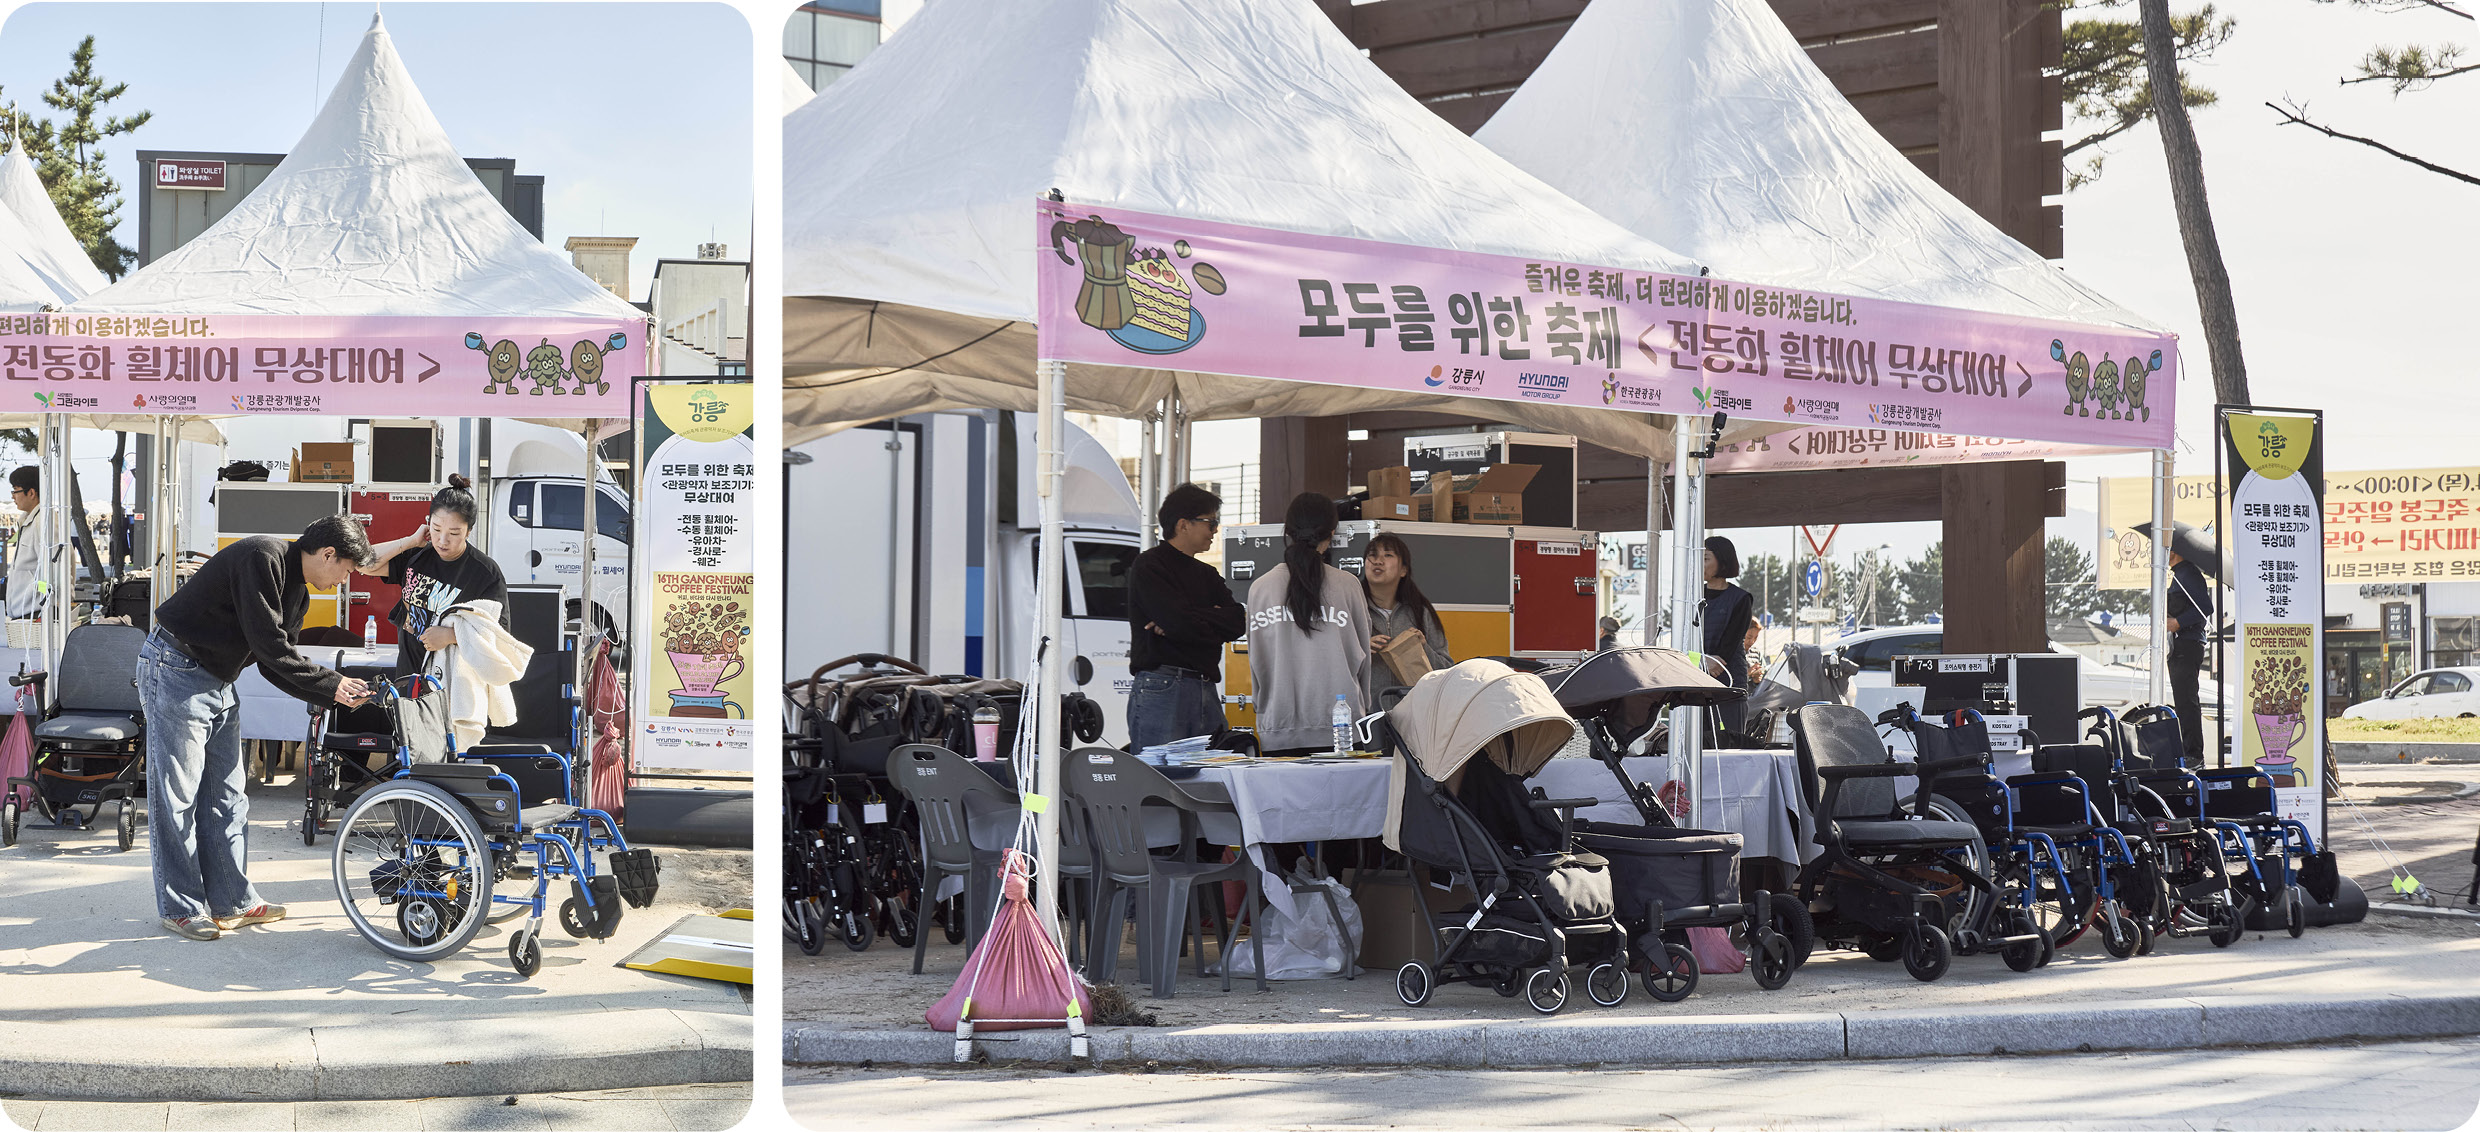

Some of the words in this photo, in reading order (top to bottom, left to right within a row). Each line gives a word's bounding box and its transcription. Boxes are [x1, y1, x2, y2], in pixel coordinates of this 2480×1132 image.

[1525, 264, 1581, 296] 즐거운
[1588, 270, 1630, 304] 축제,
[1636, 276, 1652, 304] 더
[1658, 278, 1728, 312] 편리하게
[1734, 287, 1857, 326] 이용하겠습니다.
[0, 316, 69, 336] 편리하게
[75, 317, 215, 337] 이용하겠습니다.
[1297, 279, 1435, 352] 모두를
[1448, 292, 1532, 360] 위한
[1544, 302, 1621, 369] 축제
[1638, 323, 1657, 366] <
[1666, 320, 1770, 377] 전동화
[1780, 331, 1878, 387] 휠체어
[1888, 344, 2008, 398] 무상대여
[2016, 361, 2032, 398] >
[3, 345, 115, 381] 전동화
[126, 345, 239, 382] 휠체어
[253, 347, 404, 384] 무상대여
[418, 352, 440, 383] >
[1452, 368, 1484, 385] 강릉시
[1518, 372, 1569, 388] HYUNDAI
[1621, 386, 1661, 400] 한국관광공사
[57, 397, 98, 408] 그린라이트
[149, 395, 197, 406] 사랑의열매
[247, 395, 321, 406] 강릉관광개발공사
[1713, 396, 1752, 410] 그린라이트
[1798, 398, 1839, 414] 사랑의열매
[688, 401, 729, 422] 강릉
[1882, 404, 1942, 421] 강릉관광개발공사
[2258, 434, 2287, 458] 강릉
[1426, 449, 1440, 458] 7-4
[267, 461, 290, 470] 즐기는
[662, 464, 699, 476] 모두를
[704, 464, 729, 476] 위한
[662, 480, 708, 490] <관광약자
[684, 492, 734, 503] 무상대여
[2244, 504, 2270, 517] 모두를
[2274, 504, 2290, 518] 위한
[2293, 504, 2310, 518] 축제
[678, 515, 701, 524] -전동
[704, 515, 738, 524] 휠체어-
[678, 526, 701, 535] -수동
[704, 526, 738, 535] 휠체어-
[2245, 522, 2278, 532] <관광약자
[2280, 522, 2310, 532] 보조기기>
[688, 536, 726, 546] -유아차-
[1254, 538, 1270, 548] 6-4
[2262, 535, 2295, 548] 무상대여
[688, 547, 726, 556] -경사로-
[1632, 546, 1647, 557] GS
[692, 558, 721, 566] -웨건-
[1632, 557, 1646, 568] 25
[2258, 560, 2274, 570] -전동
[2276, 560, 2298, 571] 휠체어-
[658, 574, 678, 584] 16TH
[681, 575, 753, 584] GANGNEUNG
[2258, 572, 2274, 582] -수동
[2276, 572, 2298, 582] 휠체어-
[663, 584, 702, 594] COFFEE
[704, 585, 749, 594] FESTIVAL
[2266, 584, 2291, 594] -유아차-
[2266, 596, 2291, 606] -경사로-
[2270, 608, 2288, 618] -웨건-
[1250, 606, 1348, 632] ESSENALS
[2246, 626, 2261, 636] 16TH
[2262, 626, 2311, 636] GANGNEUNG
[2250, 638, 2276, 648] COFFEE
[2278, 638, 2308, 648] FESTIVAL
[1917, 660, 1932, 670] 7-3
